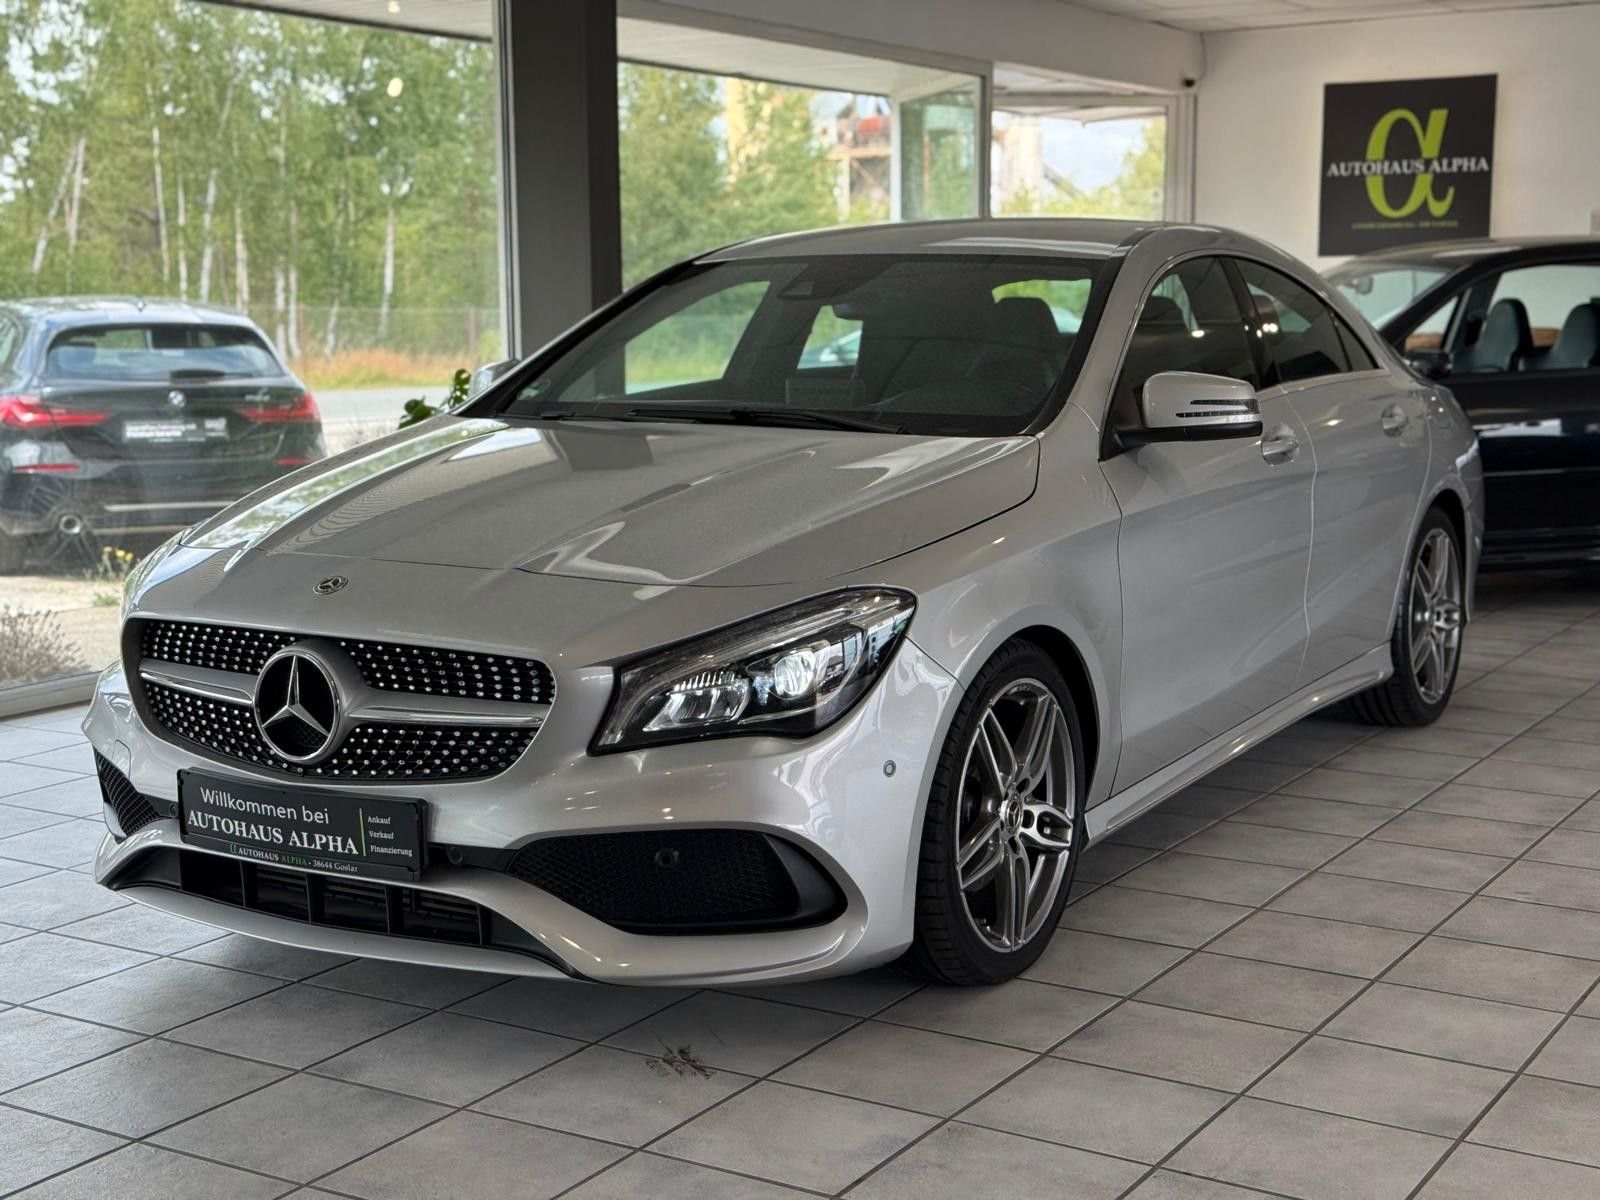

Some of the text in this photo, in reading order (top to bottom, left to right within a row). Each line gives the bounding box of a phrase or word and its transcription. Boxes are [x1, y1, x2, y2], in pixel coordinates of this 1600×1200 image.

[1327, 156, 1490, 177] AUTOHAUS ALPHA
[200, 786, 329, 824] Willkommen bei
[368, 815, 391, 825] Ankauf
[187, 809, 359, 855] AUTOHAUS ALPHA
[369, 830, 394, 840] Verkauf
[238, 847, 279, 861] AUTOHAUS
[281, 855, 307, 867] ALPHA
[312, 859, 333, 869] 38644
[333, 862, 358, 873] Goslar
[370, 844, 413, 857] Finanzierung
